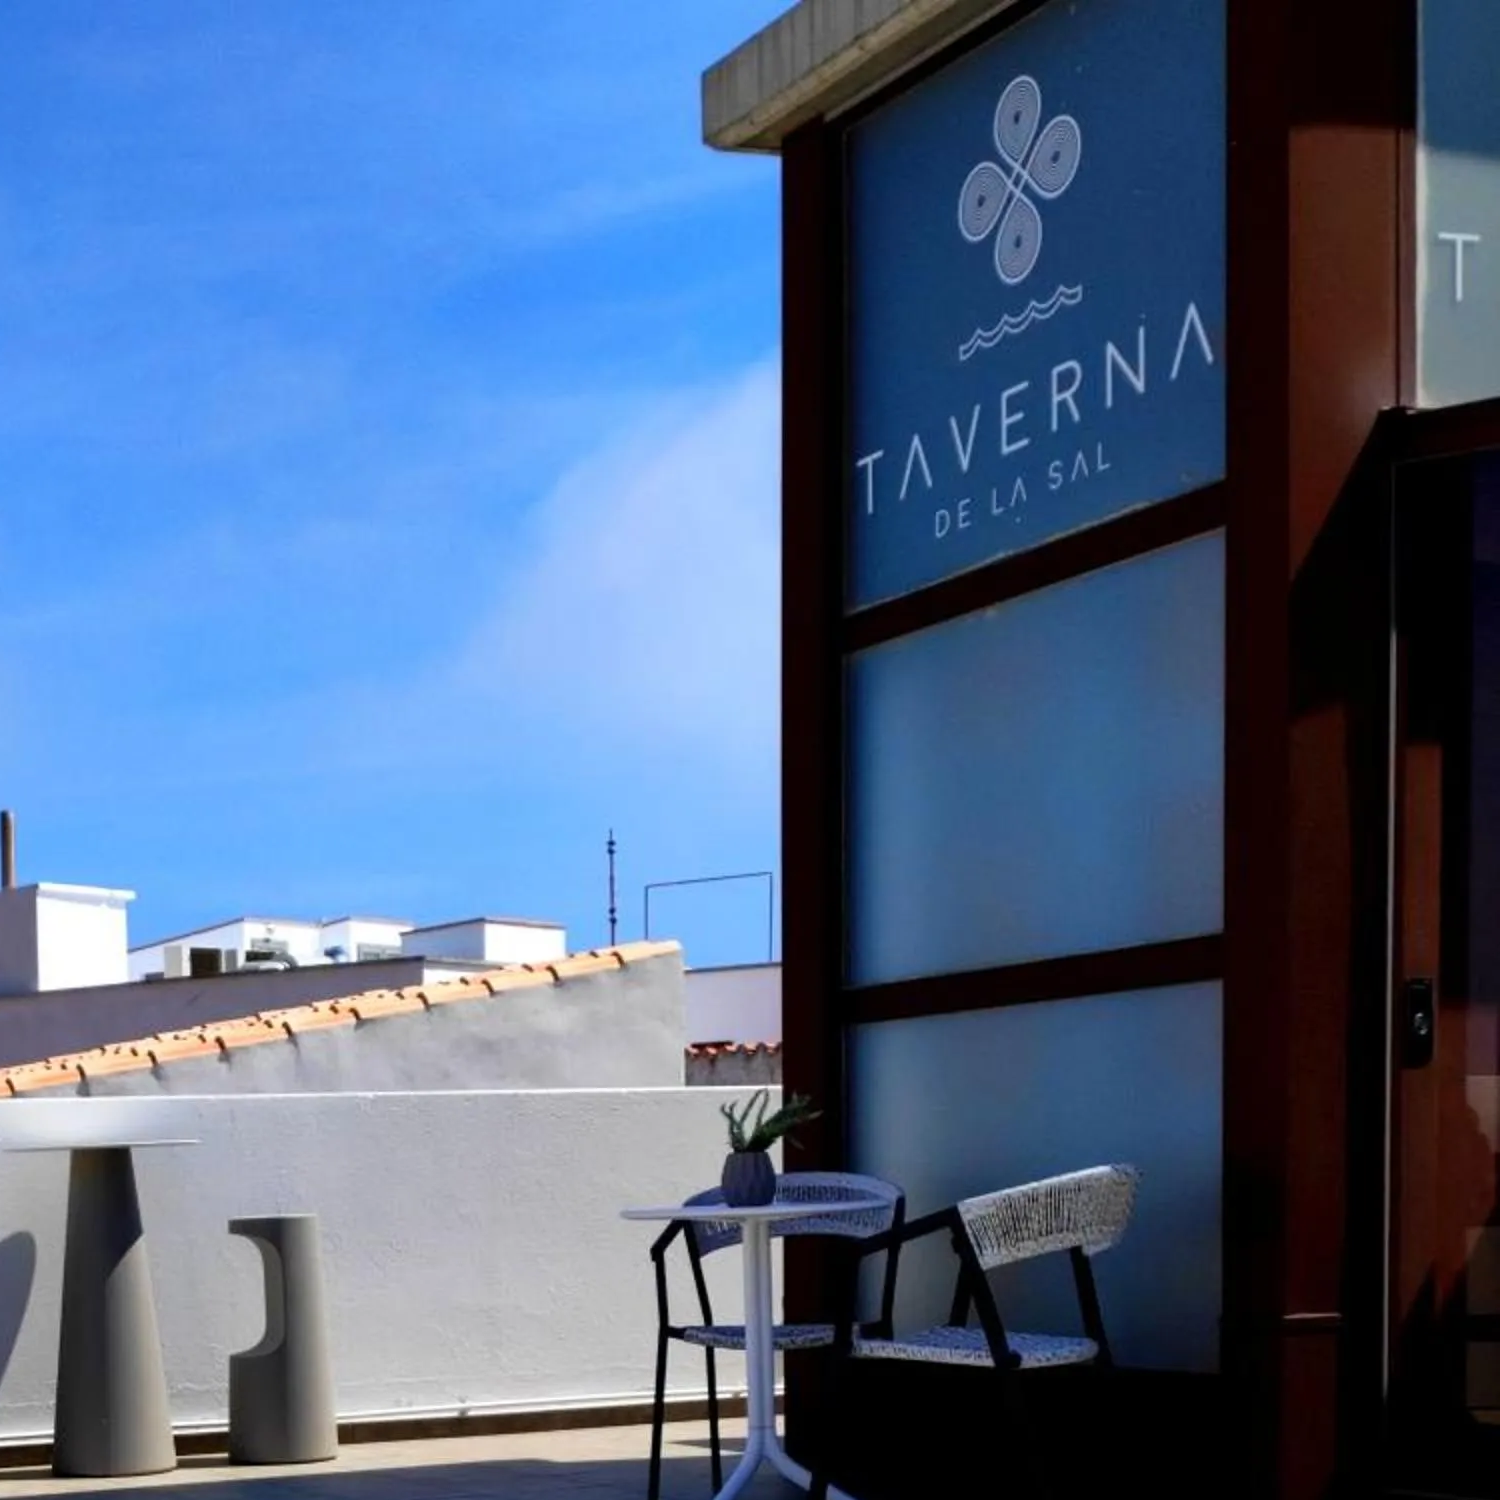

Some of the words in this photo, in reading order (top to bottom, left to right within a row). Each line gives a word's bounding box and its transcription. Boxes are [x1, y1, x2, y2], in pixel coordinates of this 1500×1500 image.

[856, 301, 1214, 516] TAVERNA
[934, 498, 972, 539] DE
[990, 475, 1027, 516] LA
[1048, 442, 1111, 490] SAL
